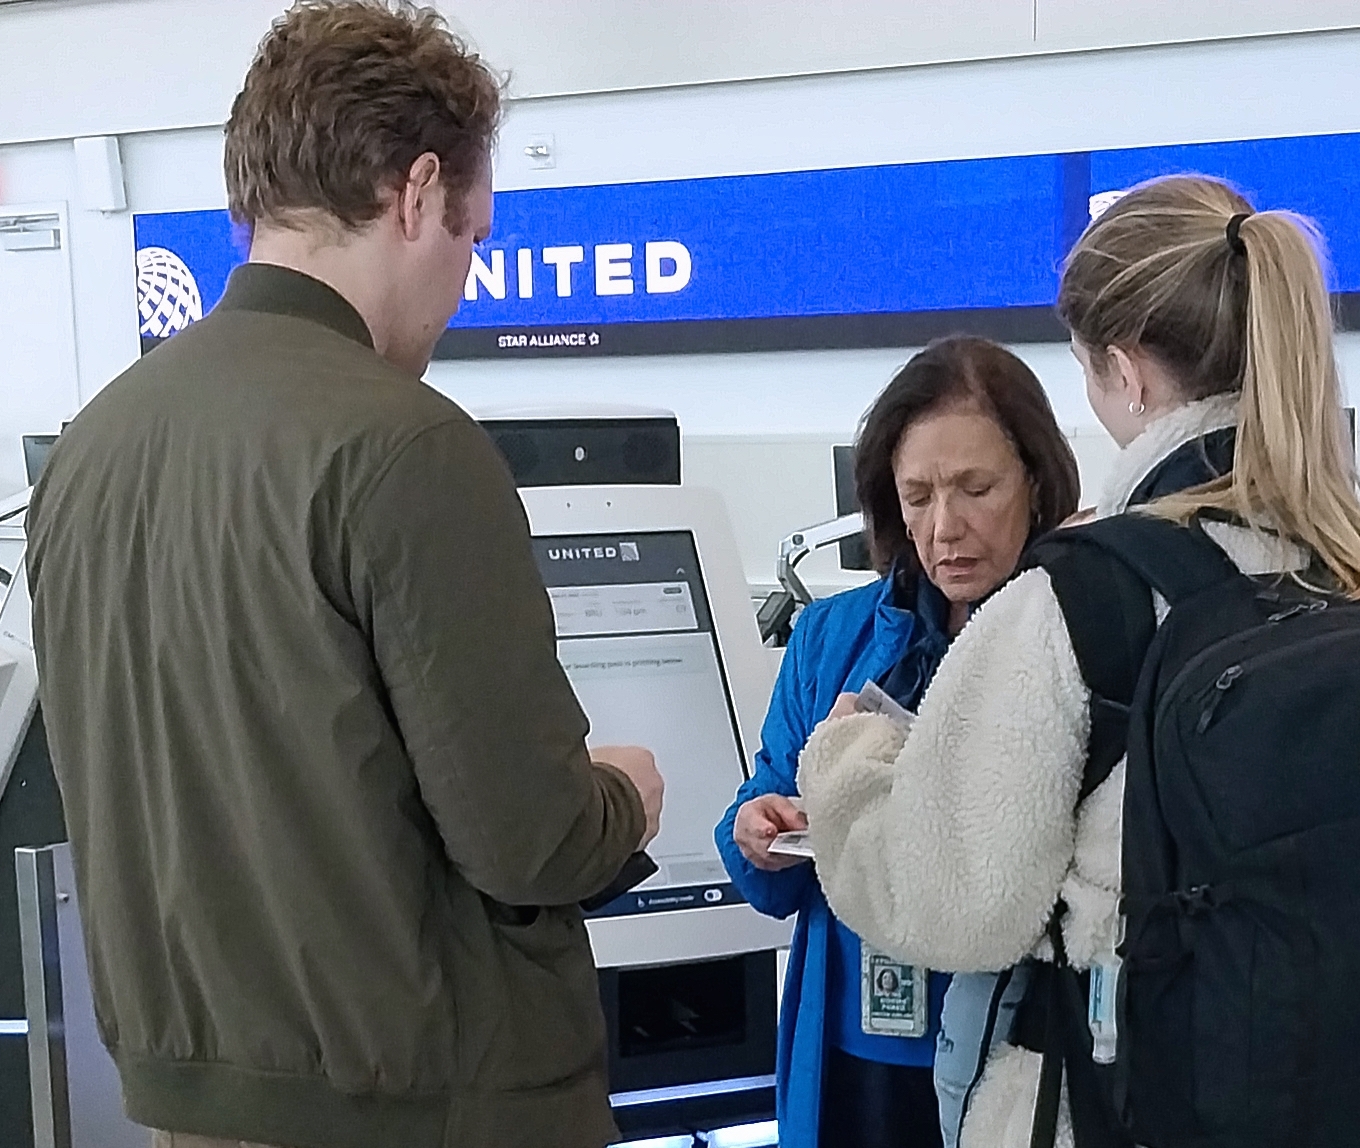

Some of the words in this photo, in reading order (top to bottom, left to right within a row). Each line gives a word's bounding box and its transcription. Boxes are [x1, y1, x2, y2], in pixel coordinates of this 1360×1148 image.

[464, 239, 693, 301] NITED
[497, 334, 527, 348] STAR
[529, 332, 586, 347] ALLIANCE
[548, 547, 617, 560] UNITED
